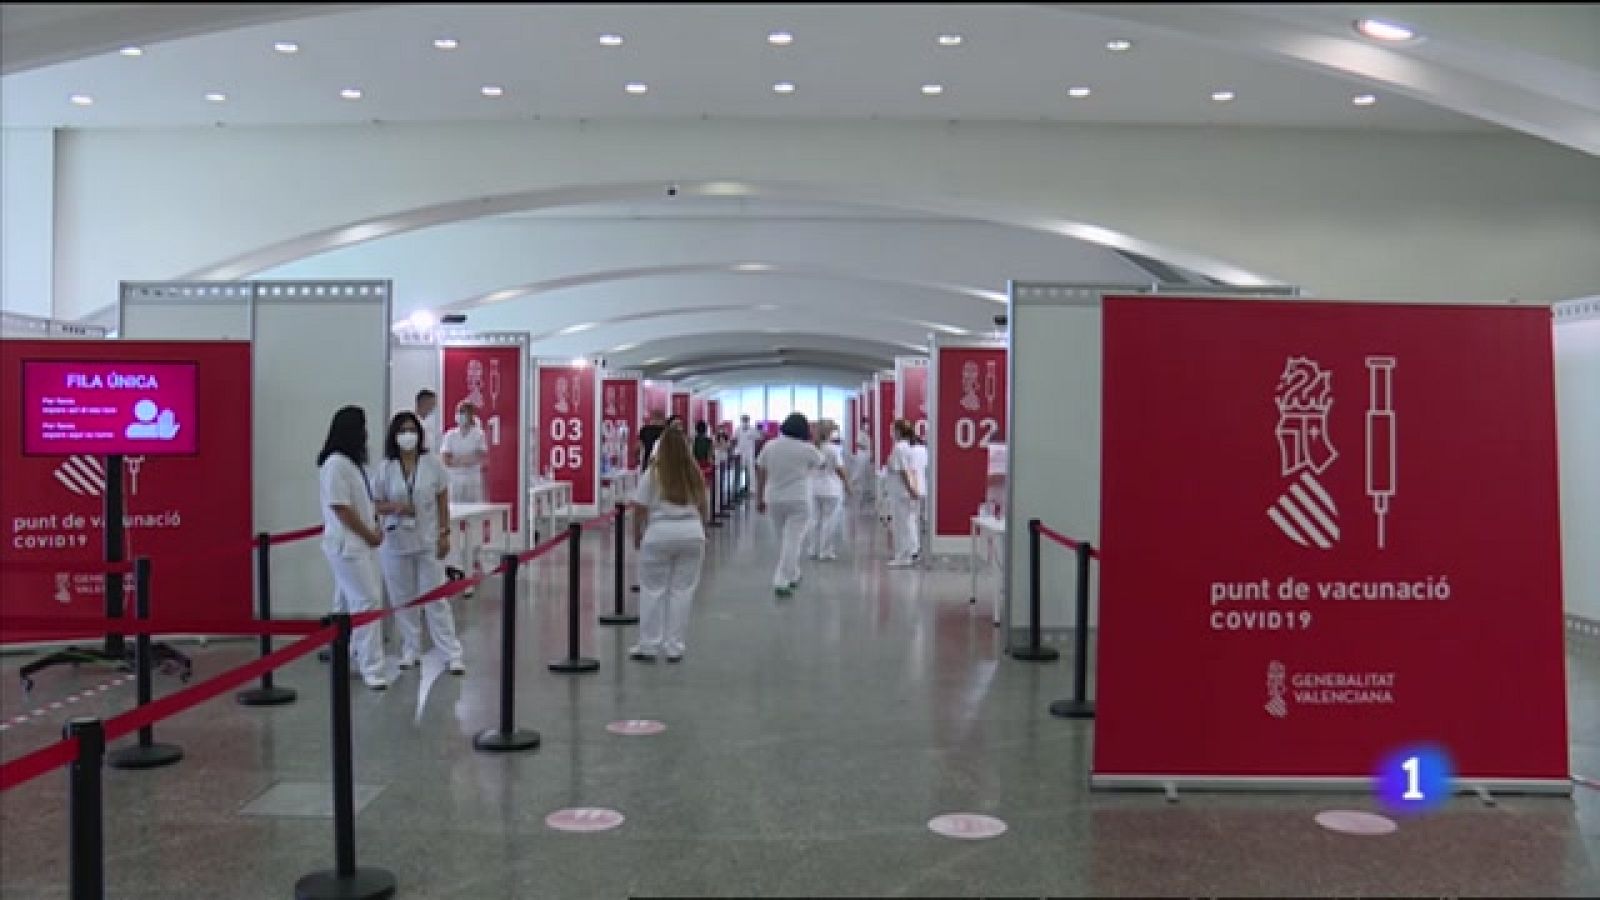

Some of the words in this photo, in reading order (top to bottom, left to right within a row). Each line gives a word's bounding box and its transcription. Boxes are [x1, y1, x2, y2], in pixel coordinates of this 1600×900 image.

[66, 374, 103, 389] FILA
[106, 371, 158, 389] ÚNICA
[551, 417, 582, 441] 03
[955, 417, 998, 448] 02
[551, 445, 582, 469] 05
[13, 513, 56, 533] punt
[62, 511, 86, 529] de
[13, 534, 88, 549] COVID19
[1210, 577, 1270, 605] punt
[1277, 576, 1310, 600] de
[1316, 575, 1451, 600] vacunació
[1210, 609, 1312, 630] COVID19
[1291, 672, 1395, 688] GENERALITAT
[1293, 689, 1395, 704] VALENCIANA
